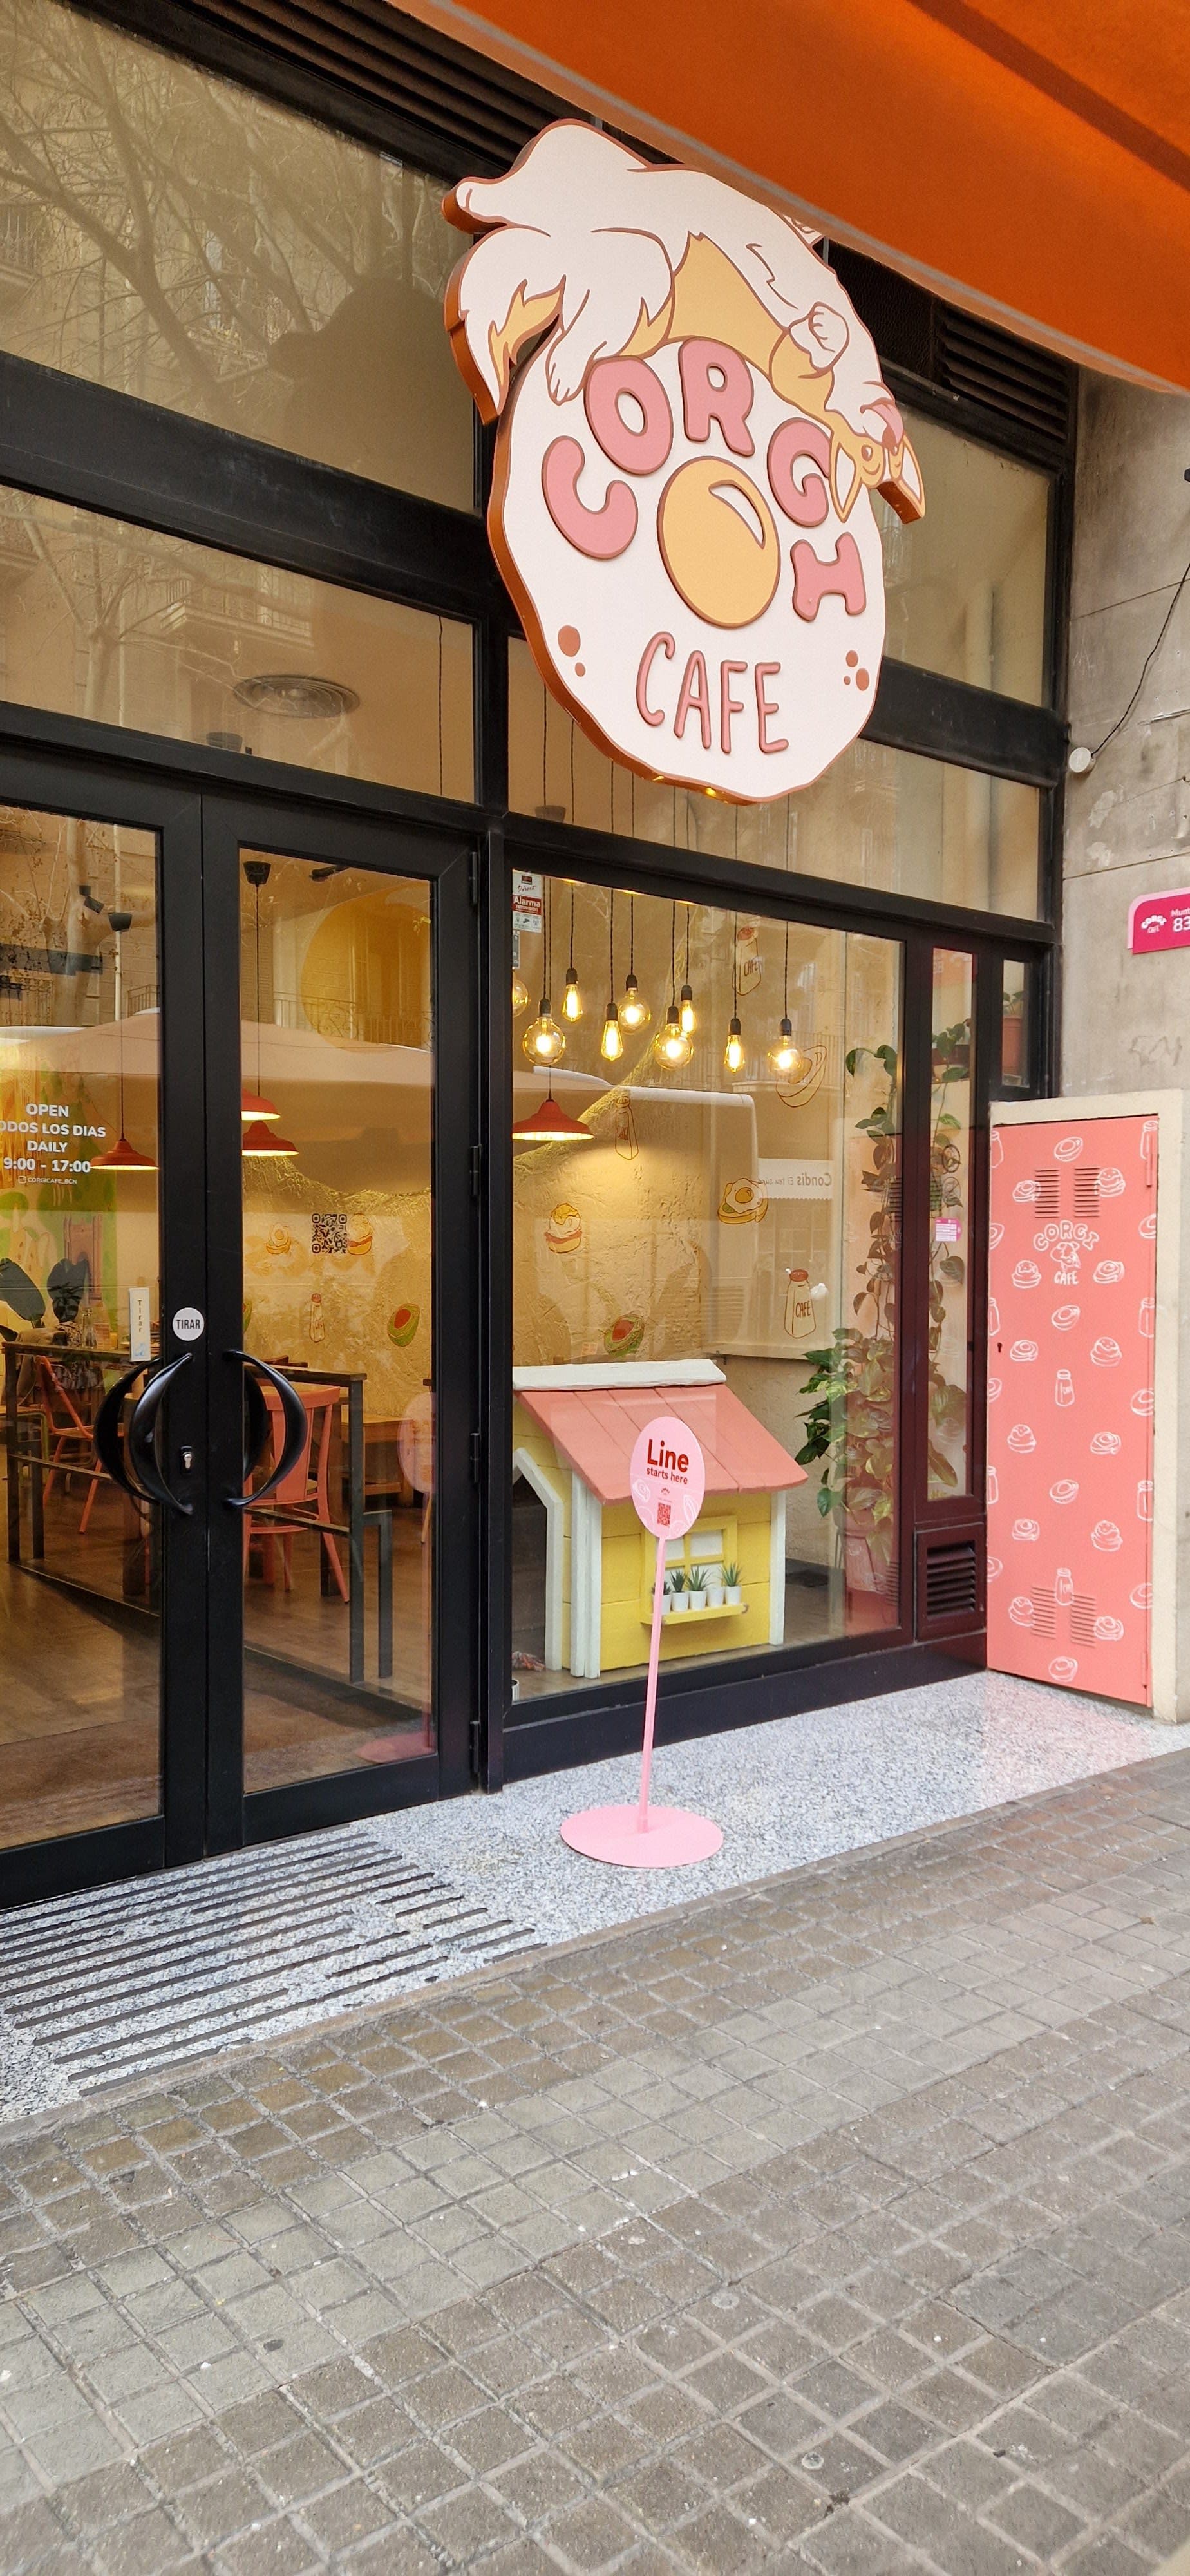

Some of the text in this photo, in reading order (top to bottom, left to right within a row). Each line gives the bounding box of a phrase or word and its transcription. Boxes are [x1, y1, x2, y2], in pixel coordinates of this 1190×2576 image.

[542, 338, 867, 622] CORGI
[636, 631, 789, 754] CAFE
[514, 895, 541, 907] Alarma
[26, 1103, 69, 1117] OPEN
[42, 1123, 70, 1135] LOS
[73, 1125, 106, 1138] DIAS
[27, 1140, 68, 1153] DAILY
[3, 1157, 35, 1170] 9:00
[52, 1159, 91, 1173] 17:00
[1033, 1220, 1100, 1251] CORGI
[1054, 1270, 1079, 1285] CAFE
[176, 1319, 200, 1329] TIRAR
[647, 1439, 689, 1473] Line
[647, 1467, 688, 1484] starts here
